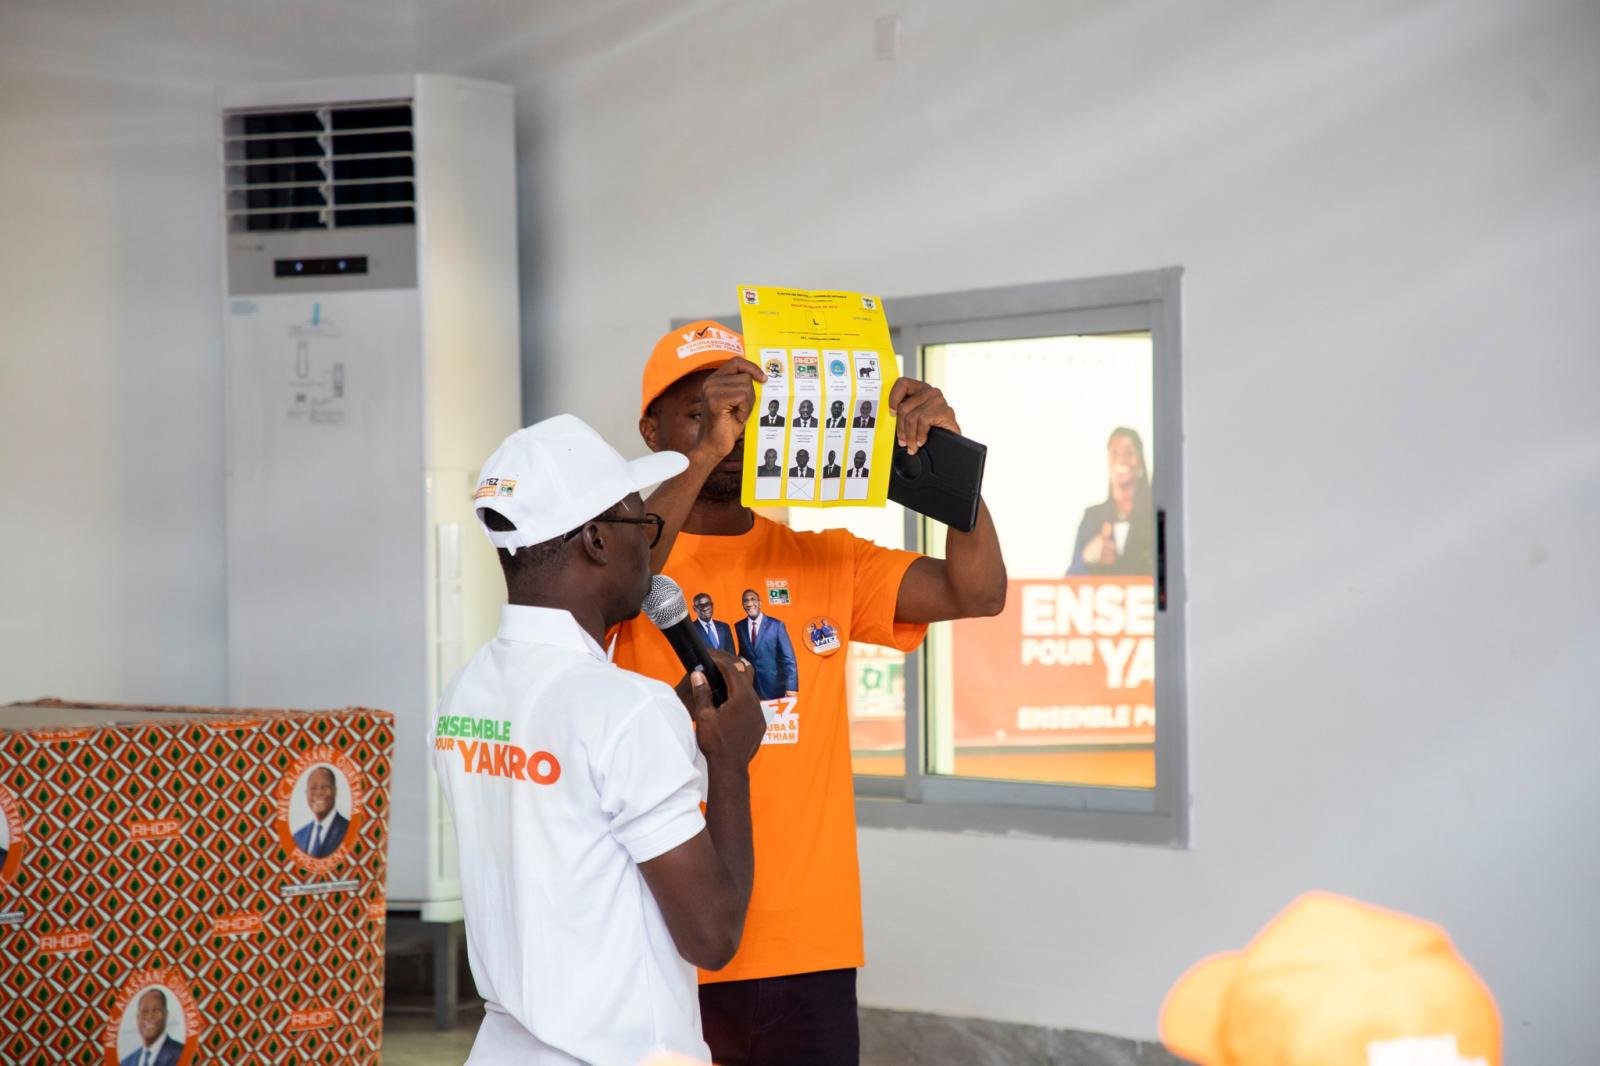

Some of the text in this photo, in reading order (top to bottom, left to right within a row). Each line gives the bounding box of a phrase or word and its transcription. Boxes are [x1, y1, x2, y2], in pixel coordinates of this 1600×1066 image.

[1022, 640, 1092, 665] POUR
[436, 715, 511, 742] ENSEMBLE
[788, 720, 797, 730] &
[457, 740, 561, 785] YAKRO
[131, 821, 178, 837] RHDP
[215, 917, 259, 930] RHDP
[41, 933, 90, 949] RHDP
[292, 1011, 333, 1026] RHDP
